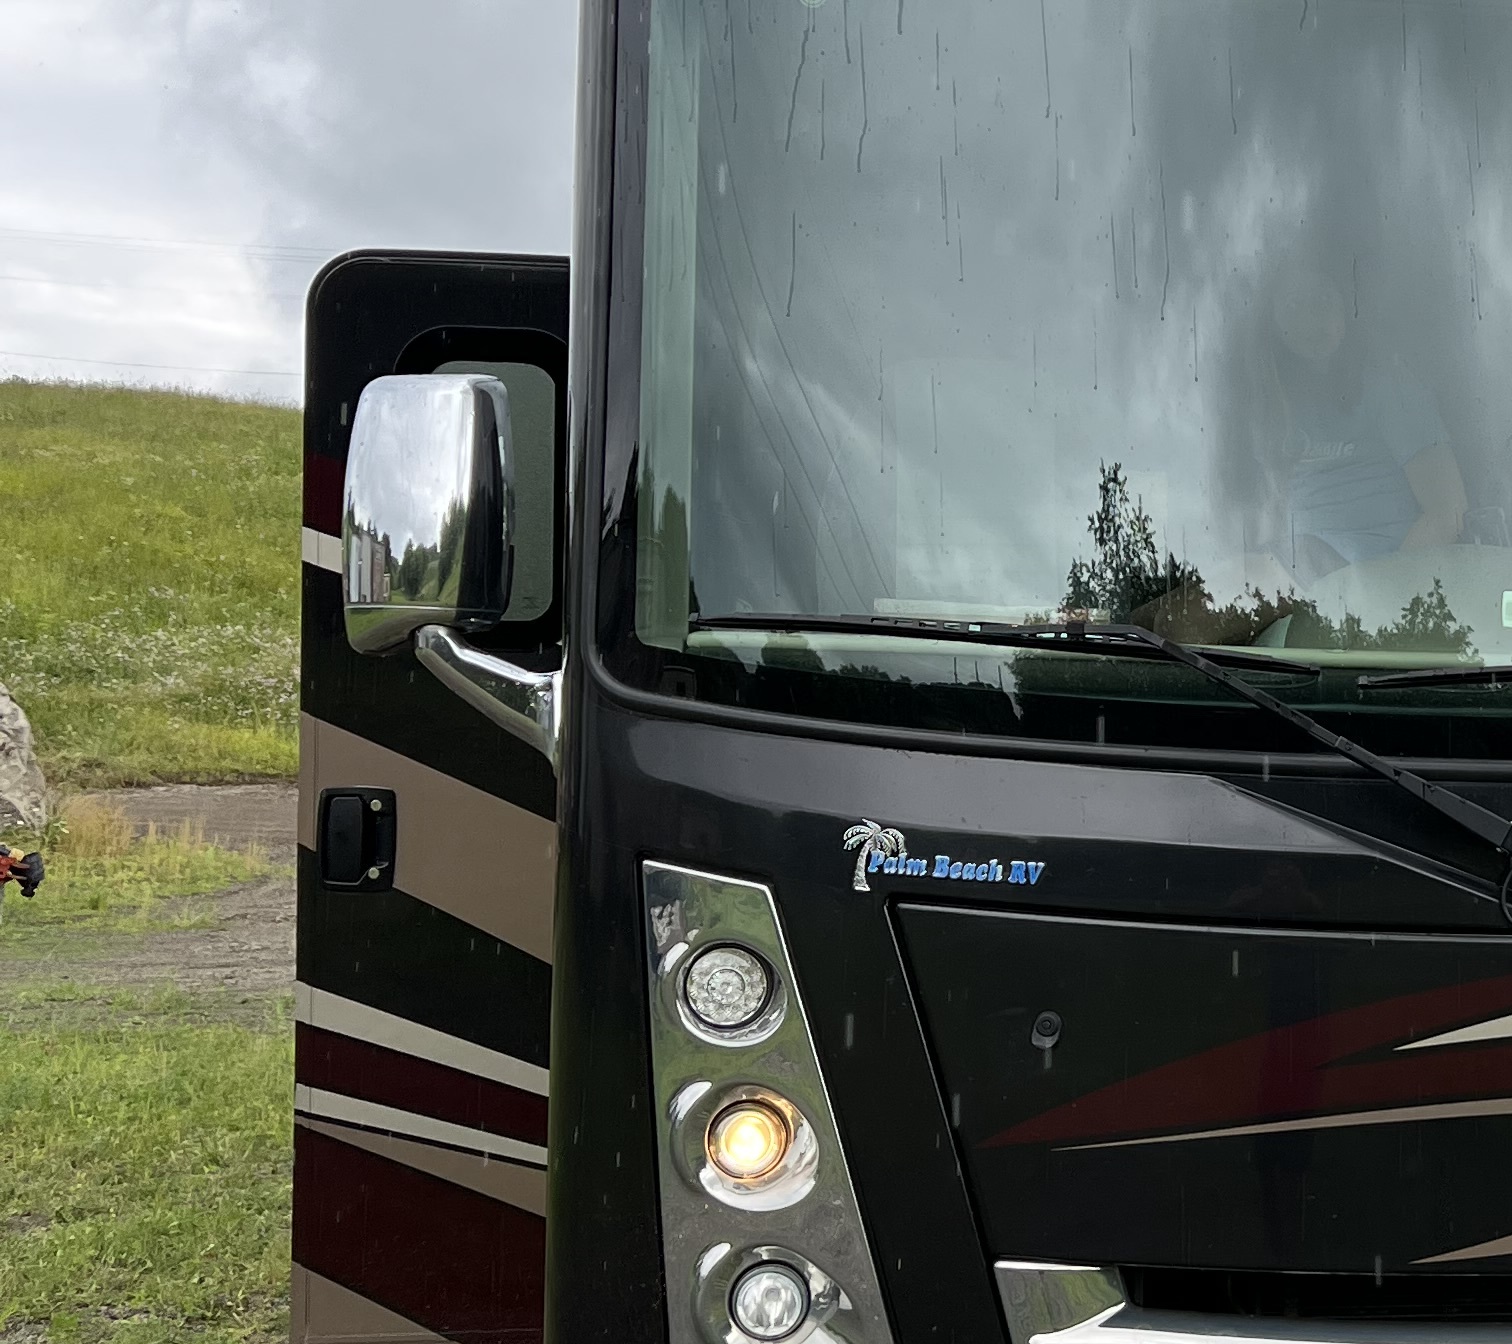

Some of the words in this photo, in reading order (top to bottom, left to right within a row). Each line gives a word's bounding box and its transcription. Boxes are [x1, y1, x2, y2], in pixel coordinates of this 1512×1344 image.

[867, 850, 928, 876] Palm
[932, 855, 1003, 882] Beach
[1007, 860, 1046, 885] RV
